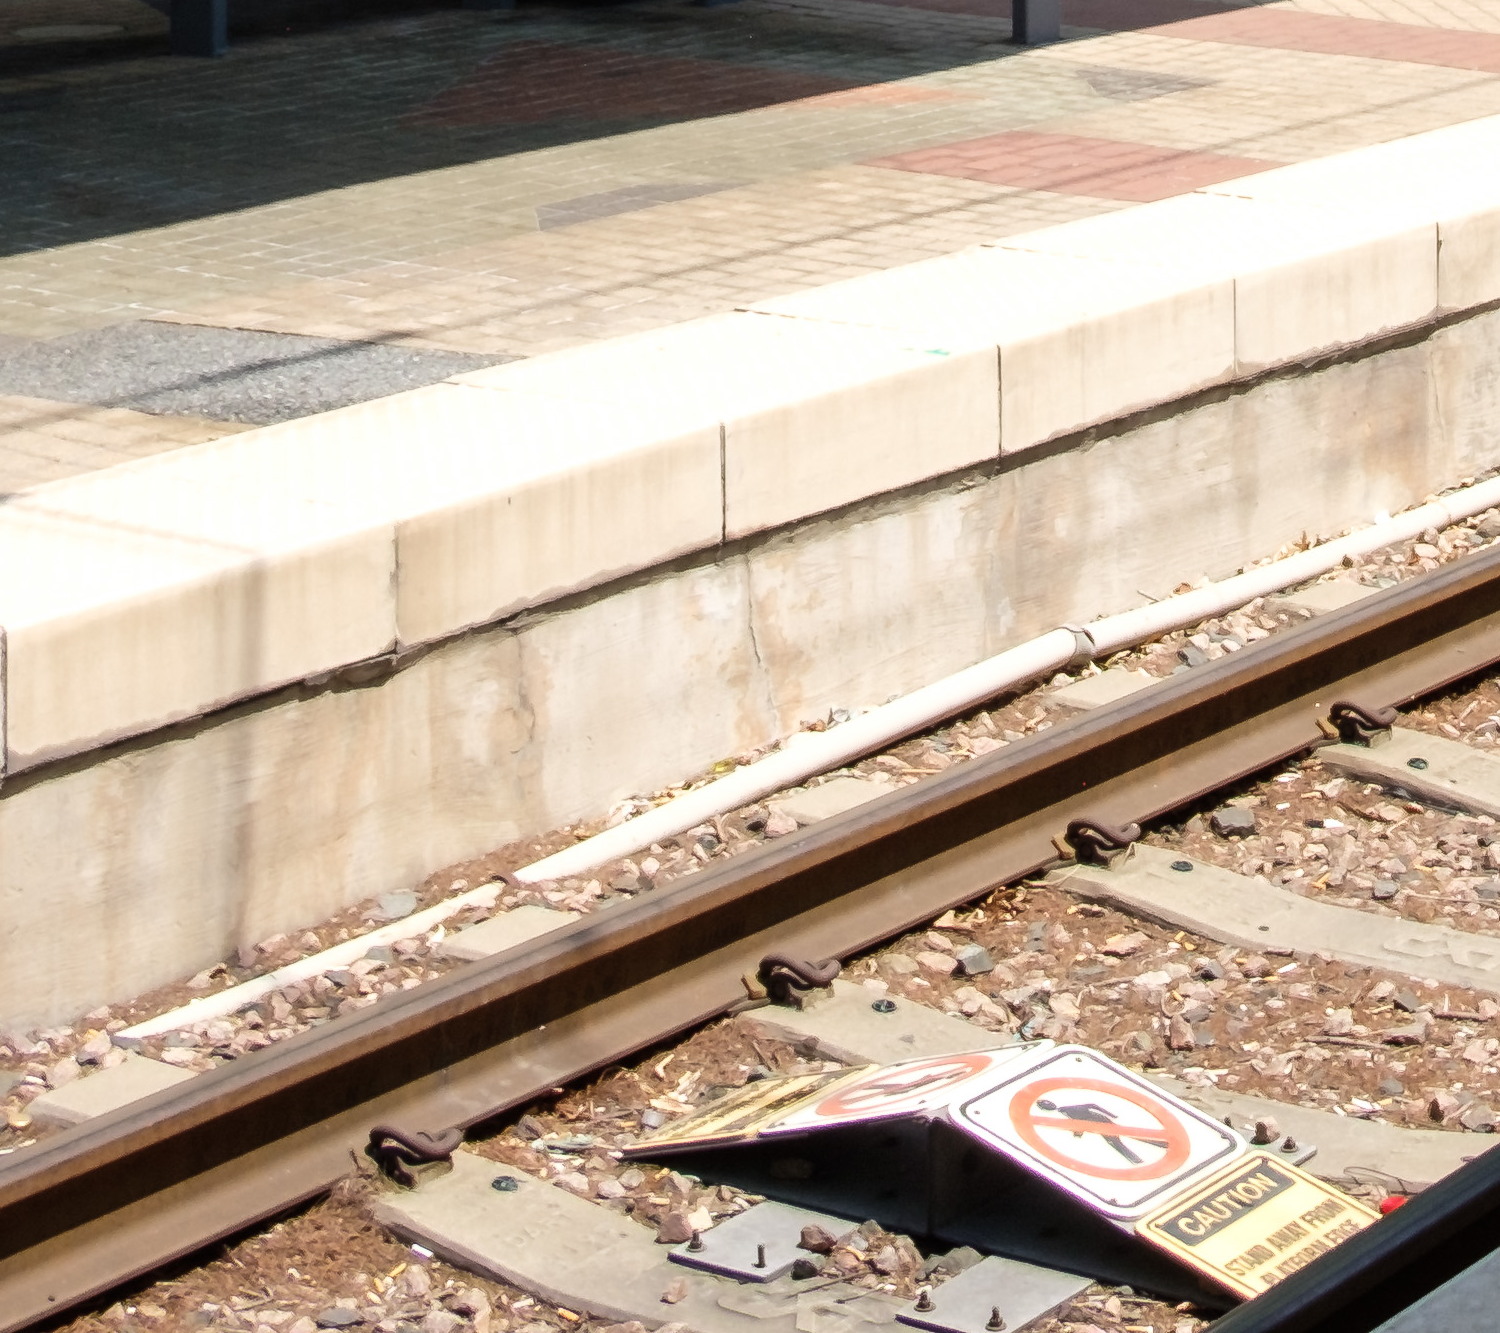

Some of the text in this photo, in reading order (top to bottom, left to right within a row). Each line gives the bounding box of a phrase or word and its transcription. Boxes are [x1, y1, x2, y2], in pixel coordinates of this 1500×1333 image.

[1175, 1171, 1279, 1237] CAUTION
[1223, 1197, 1348, 1277] STAND AWAY FROM
